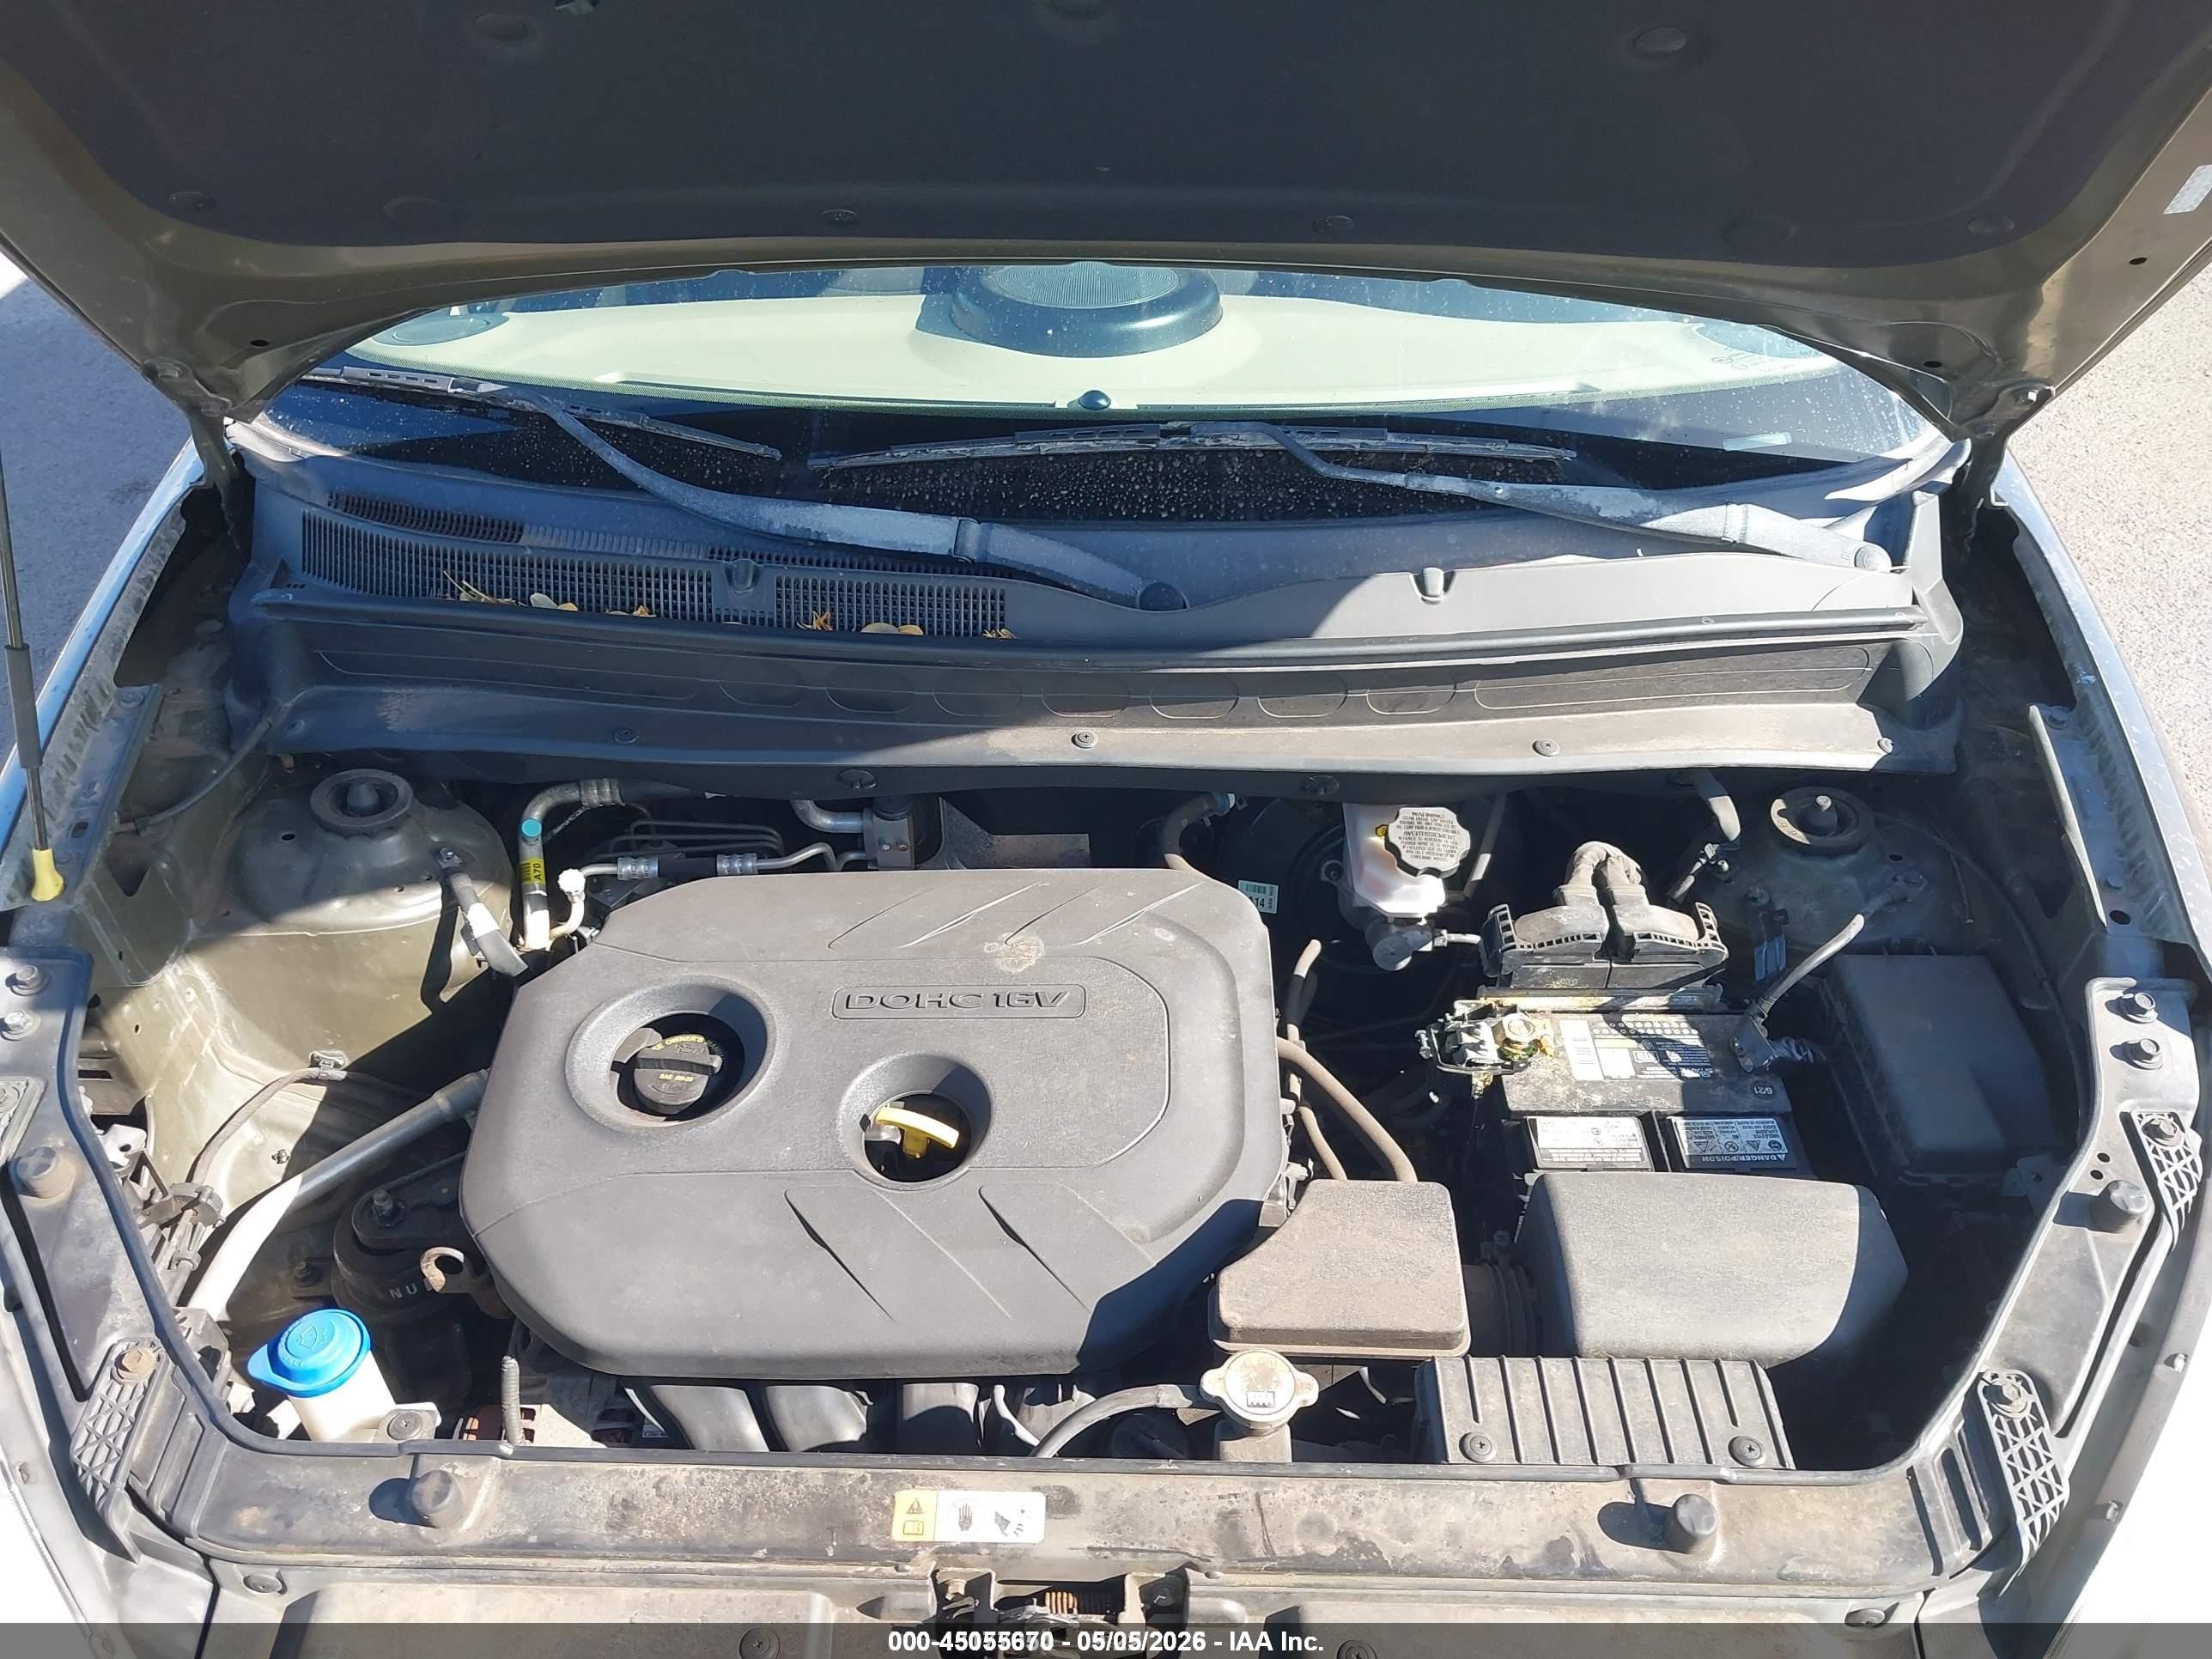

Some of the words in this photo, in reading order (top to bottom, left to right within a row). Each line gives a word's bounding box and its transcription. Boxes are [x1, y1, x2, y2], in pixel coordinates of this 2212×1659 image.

[533, 863, 542, 880] A70
[844, 991, 985, 1010] DOHC
[993, 990, 1071, 1009] 16V
[1701, 1154, 1778, 1163] DANGER/POISON
